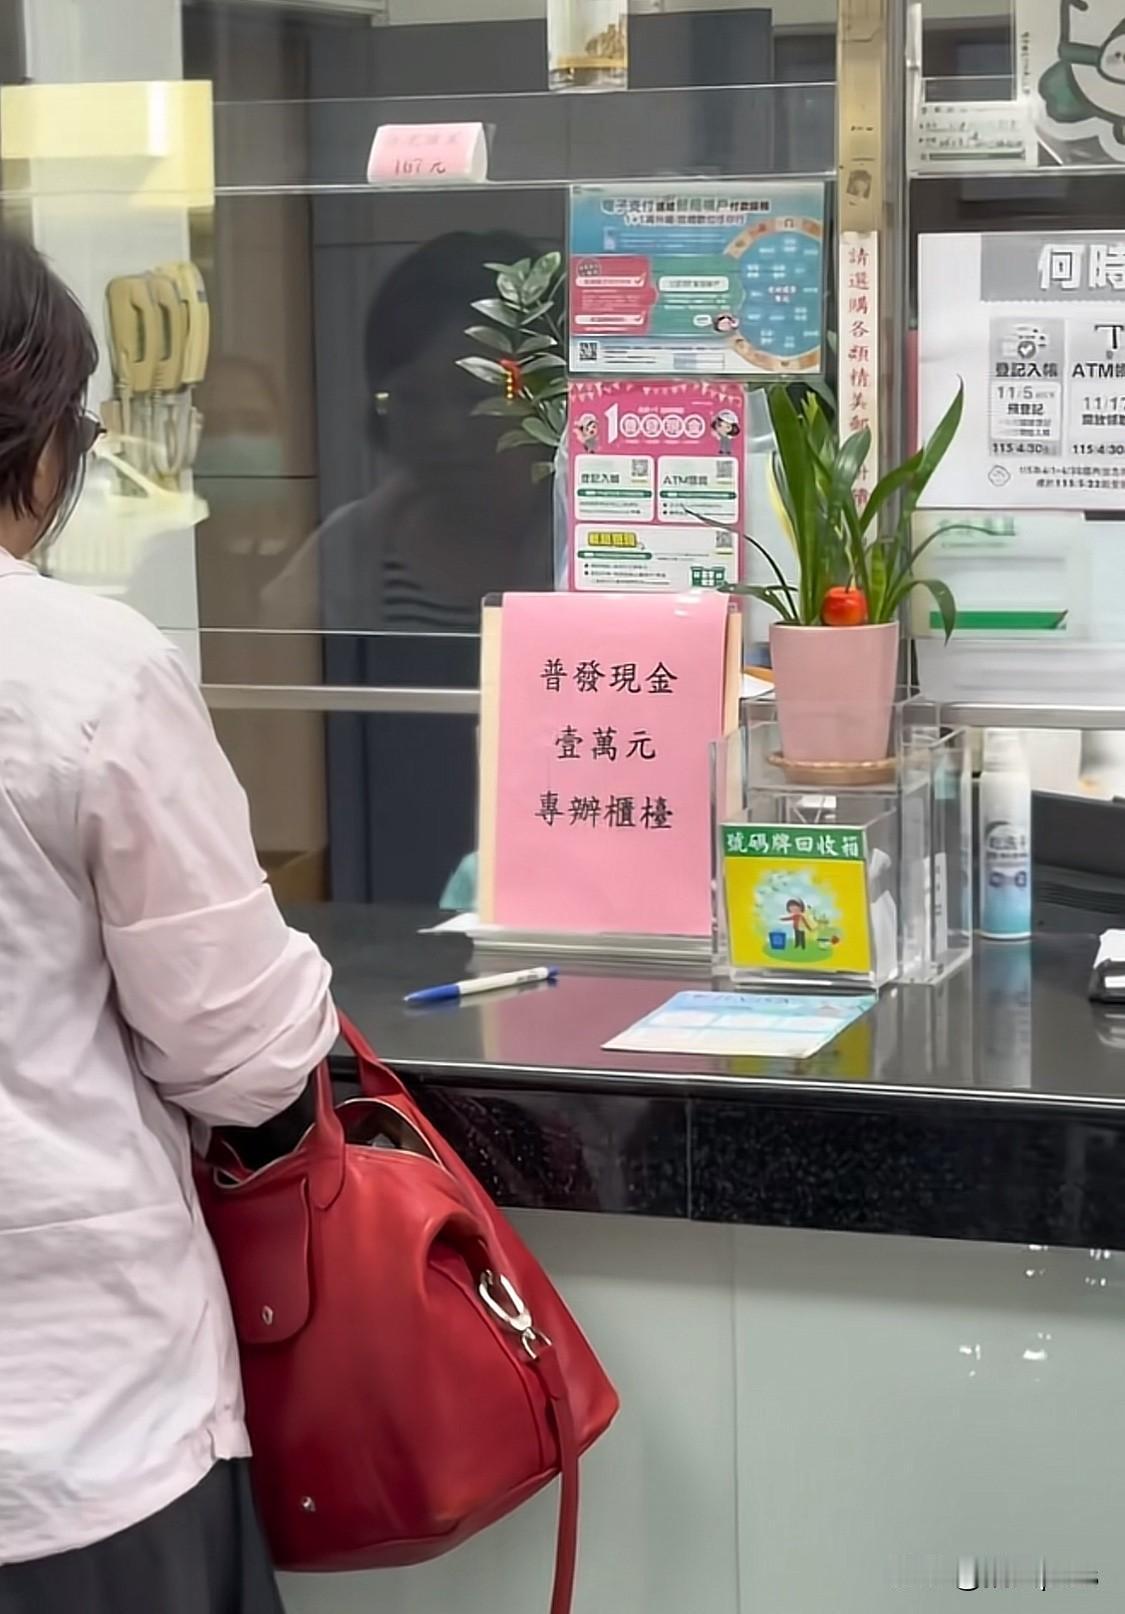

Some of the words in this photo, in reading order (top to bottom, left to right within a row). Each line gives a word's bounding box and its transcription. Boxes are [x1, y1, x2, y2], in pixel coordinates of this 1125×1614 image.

[995, 362, 1058, 378] 登記入帳
[540, 658, 678, 694] 普發現金
[555, 724, 656, 761] 壹萬元
[535, 790, 673, 829] 專辦櫃檯
[726, 831, 859, 857] 號碼牌回收箱
